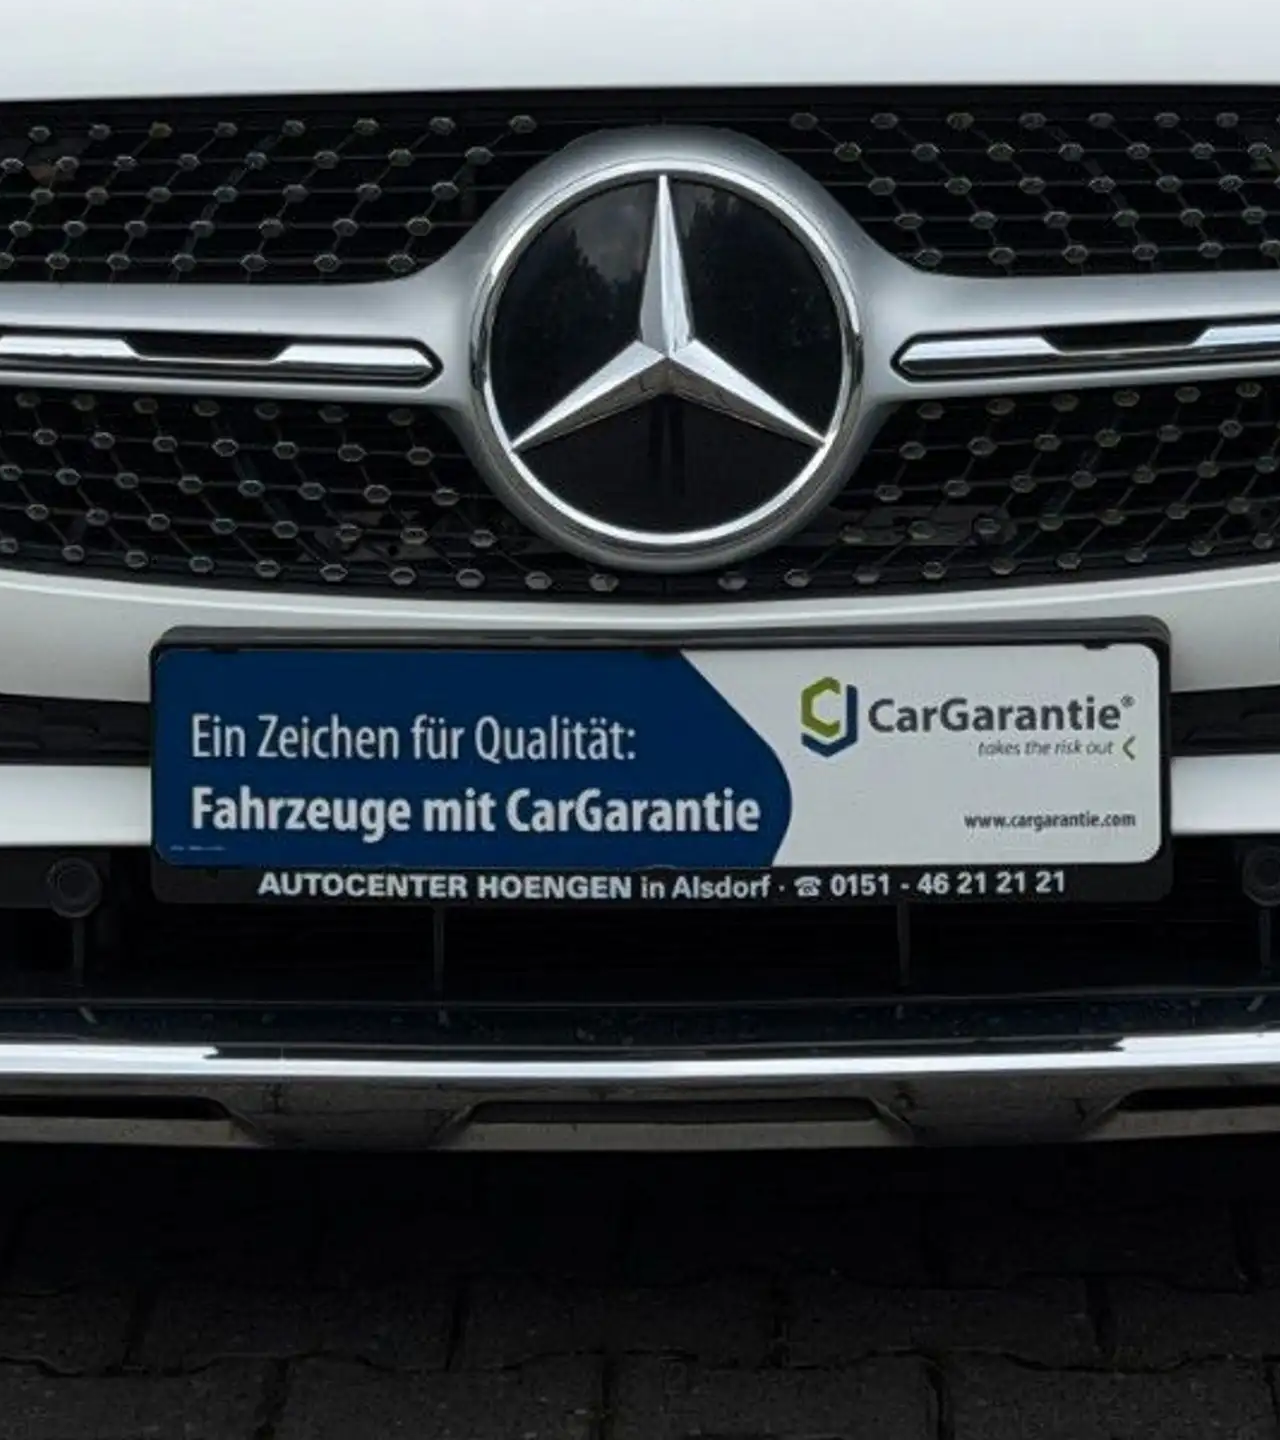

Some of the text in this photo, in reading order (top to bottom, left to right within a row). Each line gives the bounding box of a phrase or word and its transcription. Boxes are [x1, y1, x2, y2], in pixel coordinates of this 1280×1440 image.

[192, 714, 636, 764] Ein Zeichen für Qualität:
[977, 738, 1115, 758] takes the risk out
[192, 785, 762, 842] Fahrzeuge mit CarGarantie
[963, 810, 1137, 833] www.cargarantie.com
[258, 872, 468, 899] AUTOCENTER
[478, 875, 632, 899] HOENGEN
[641, 876, 665, 898] in
[672, 874, 771, 899] Alsdorf
[830, 873, 890, 897] 0151
[917, 872, 950, 895] 46
[957, 871, 986, 894] 21
[996, 871, 1025, 894] 21
[1035, 870, 1065, 893] 21
